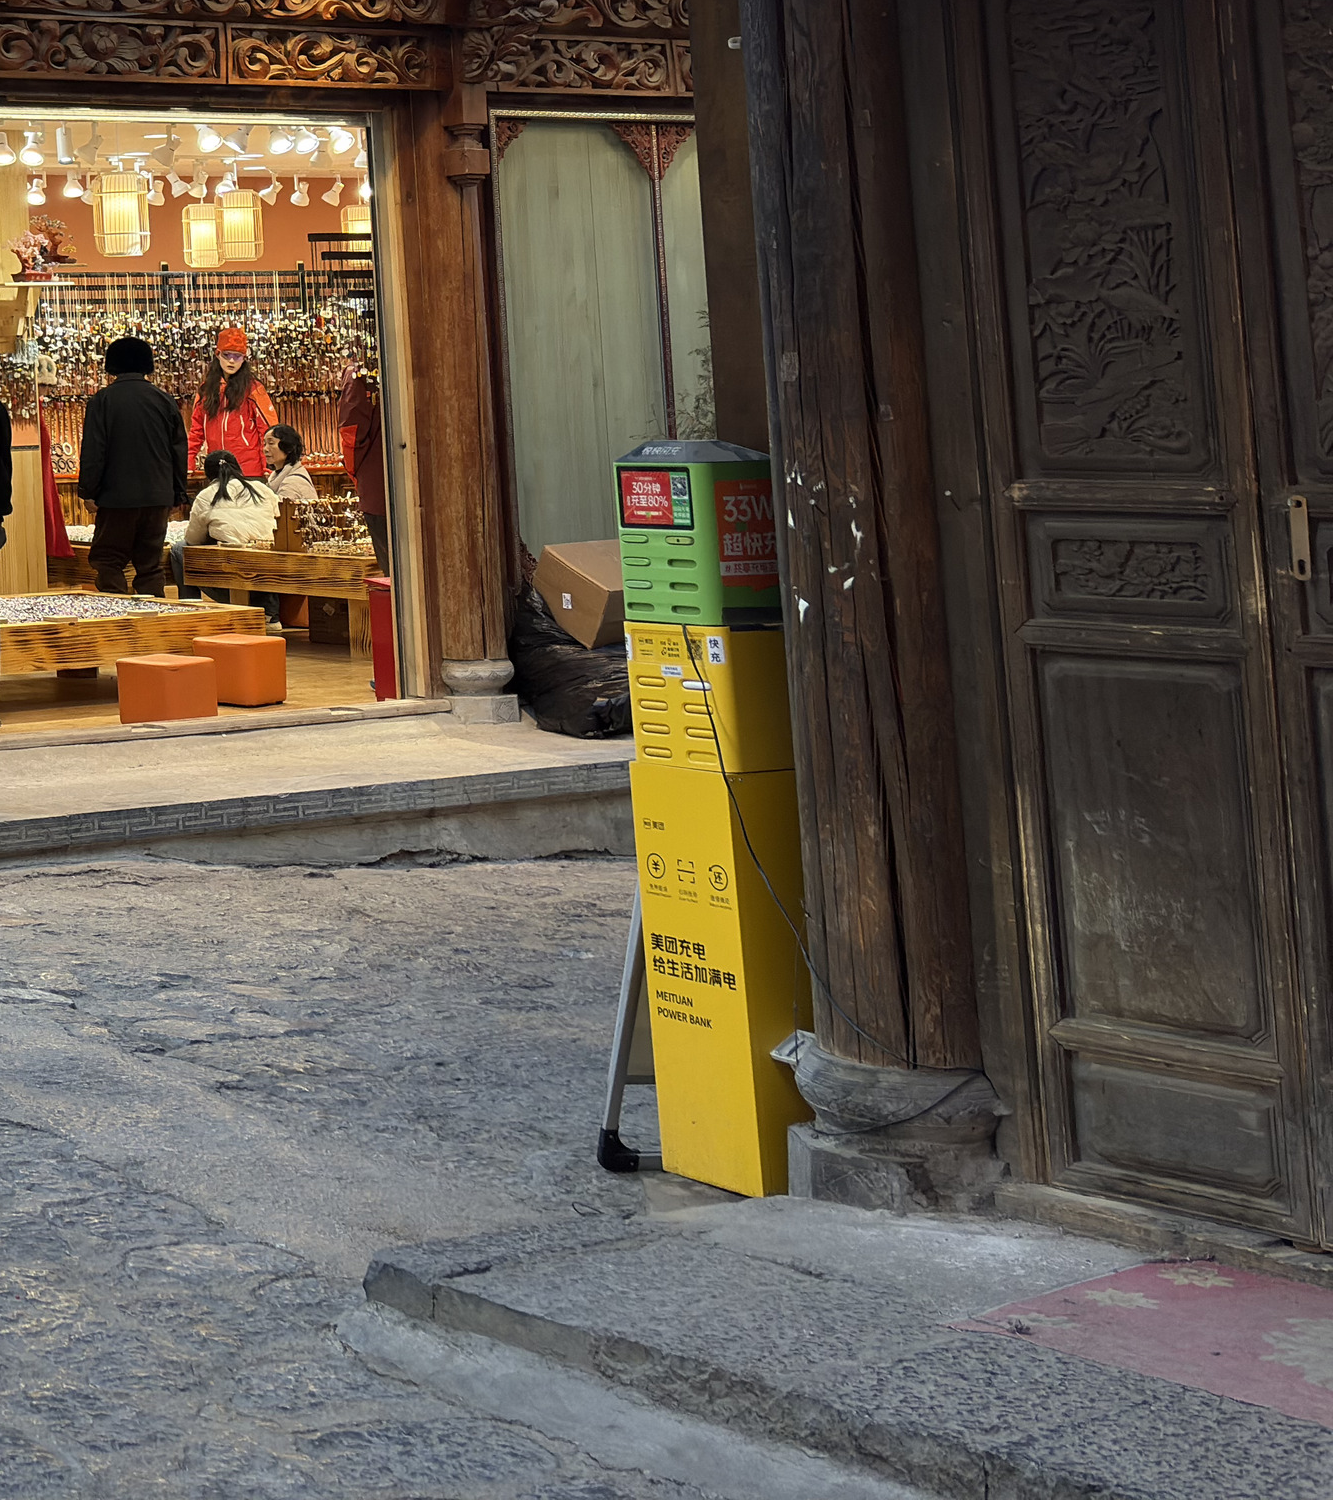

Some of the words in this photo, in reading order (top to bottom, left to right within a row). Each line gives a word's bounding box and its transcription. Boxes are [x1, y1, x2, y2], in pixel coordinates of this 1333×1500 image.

[709, 638, 721, 662] 快充
[650, 932, 707, 961] 美团充电
[652, 955, 737, 991] 给生活加满电
[656, 990, 693, 1007] MEITUAN
[657, 1006, 688, 1023] POWER
[689, 1014, 713, 1029] BANK
